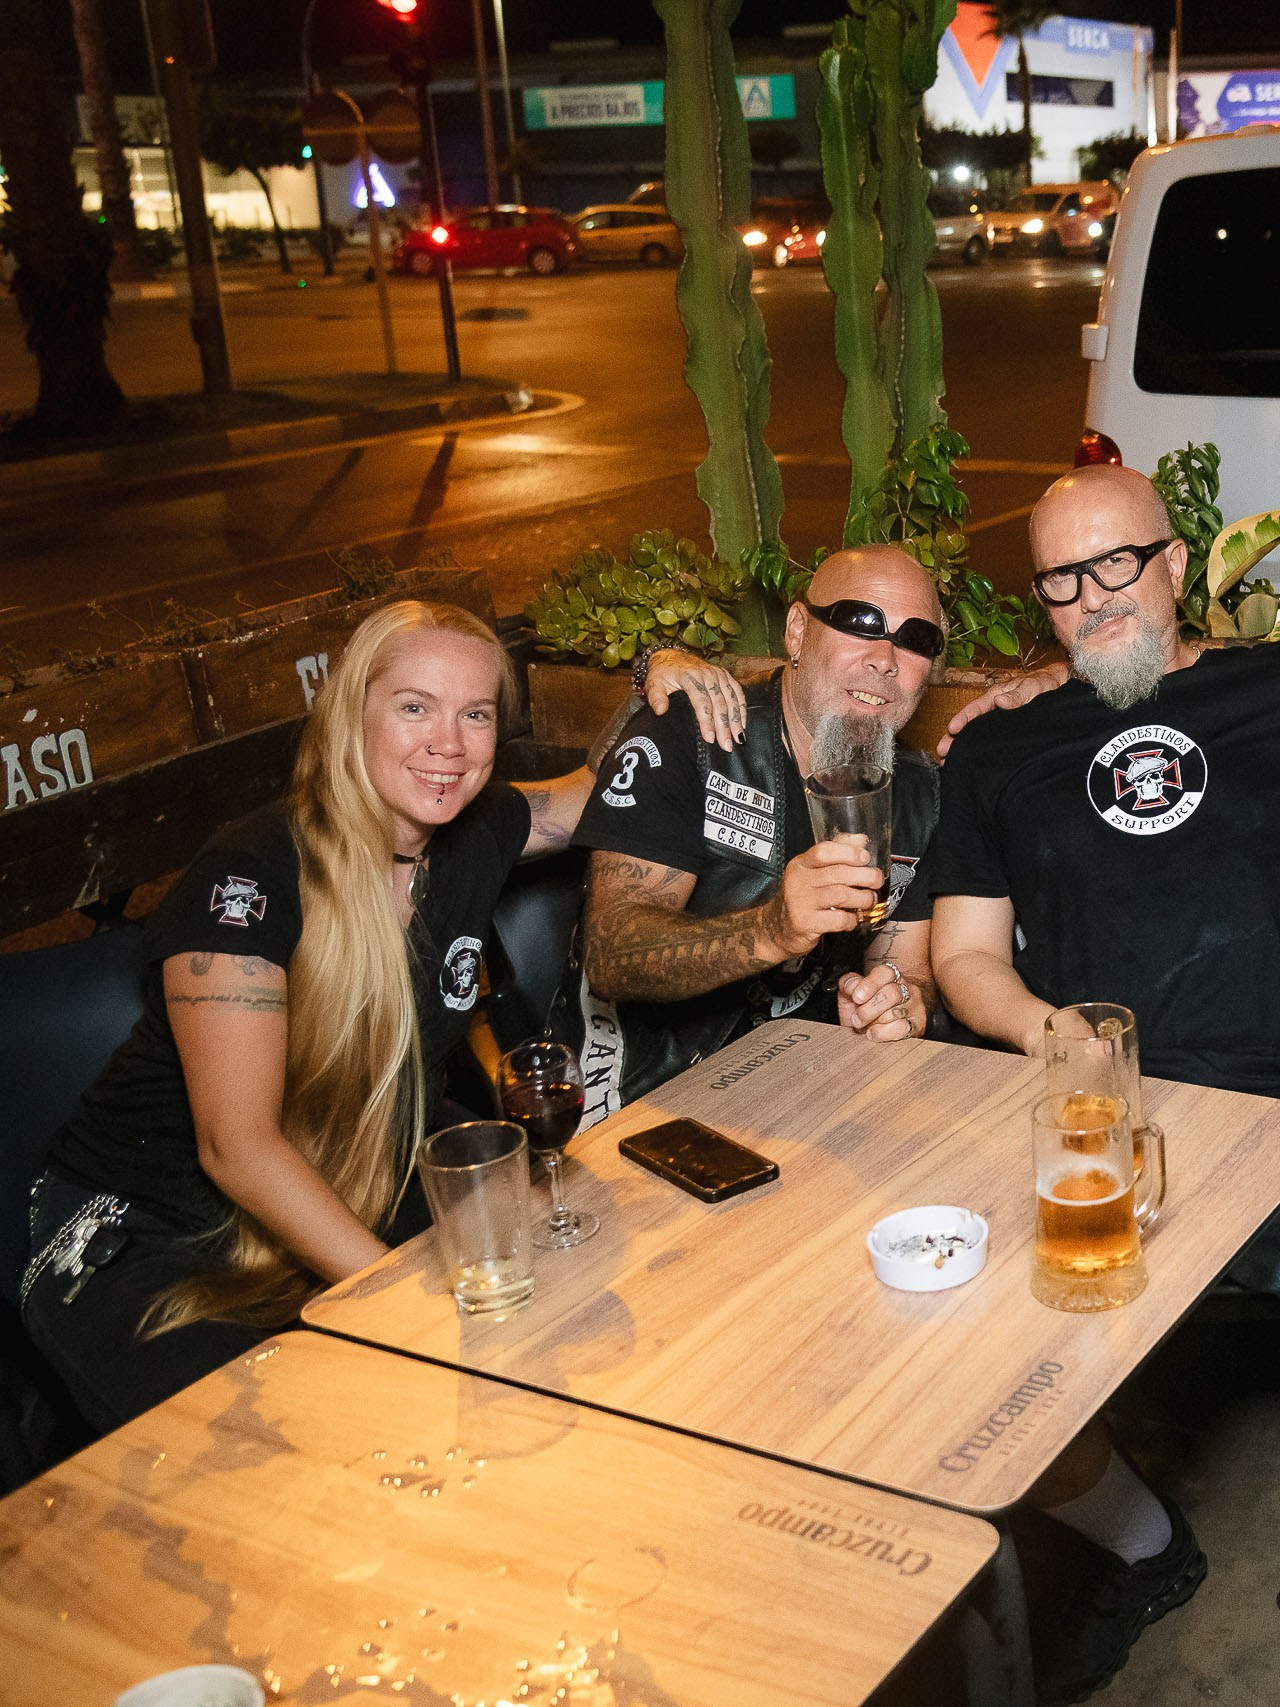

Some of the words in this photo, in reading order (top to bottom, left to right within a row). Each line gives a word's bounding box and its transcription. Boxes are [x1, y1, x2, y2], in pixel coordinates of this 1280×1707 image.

[1068, 26, 1109, 49] SERCA
[1101, 727, 1191, 764] CLANDESTINOS
[610, 751, 639, 790] 3
[709, 774, 731, 796] CAPT
[735, 787, 749, 801] DE
[751, 792, 773, 812] RUTA
[707, 798, 774, 835] CLANDESTINOS
[1111, 797, 1196, 829] SUPPORT
[710, 1033, 811, 1090] Cruzcampo
[938, 1360, 1064, 1472] Cruzcampo
[737, 1501, 933, 1576] Cruzcampo
